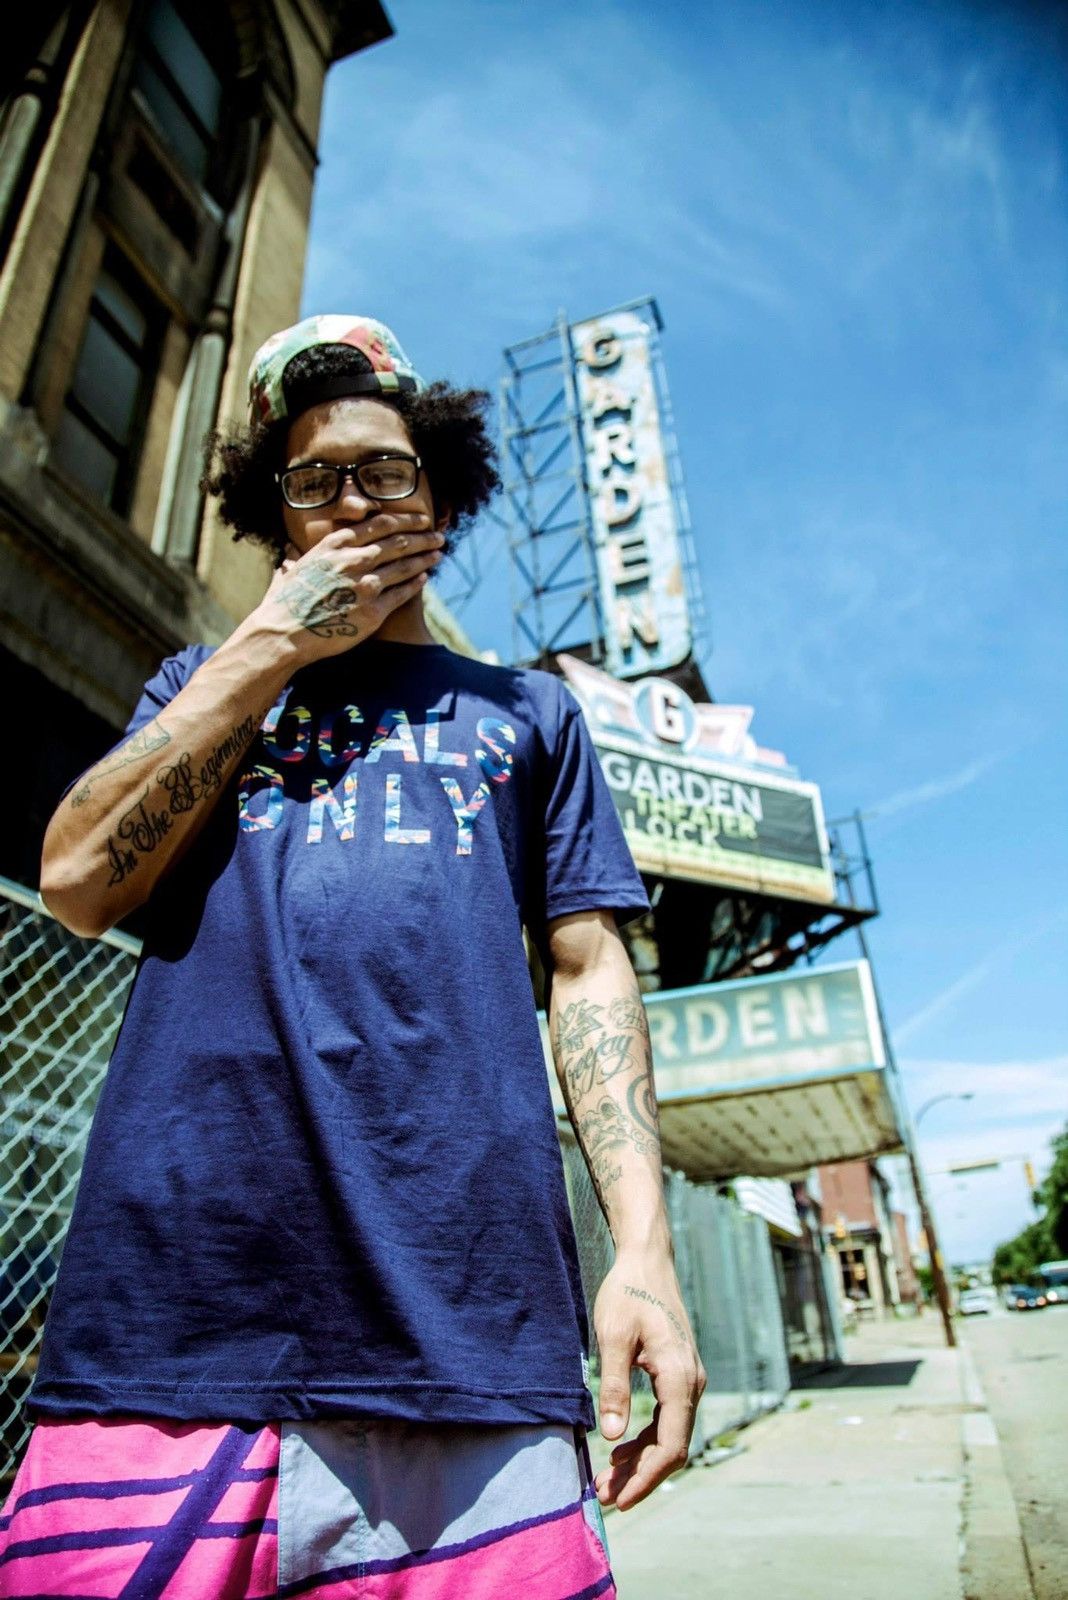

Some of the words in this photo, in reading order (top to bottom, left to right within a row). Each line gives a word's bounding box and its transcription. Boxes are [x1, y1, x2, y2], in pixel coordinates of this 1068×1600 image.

[581, 328, 660, 664] GARDEN
[117, 783, 174, 852] The
[238, 765, 491, 855] ONLY
[600, 751, 763, 822] GARDEN
[635, 790, 758, 839] THEATER
[108, 835, 138, 887] In
